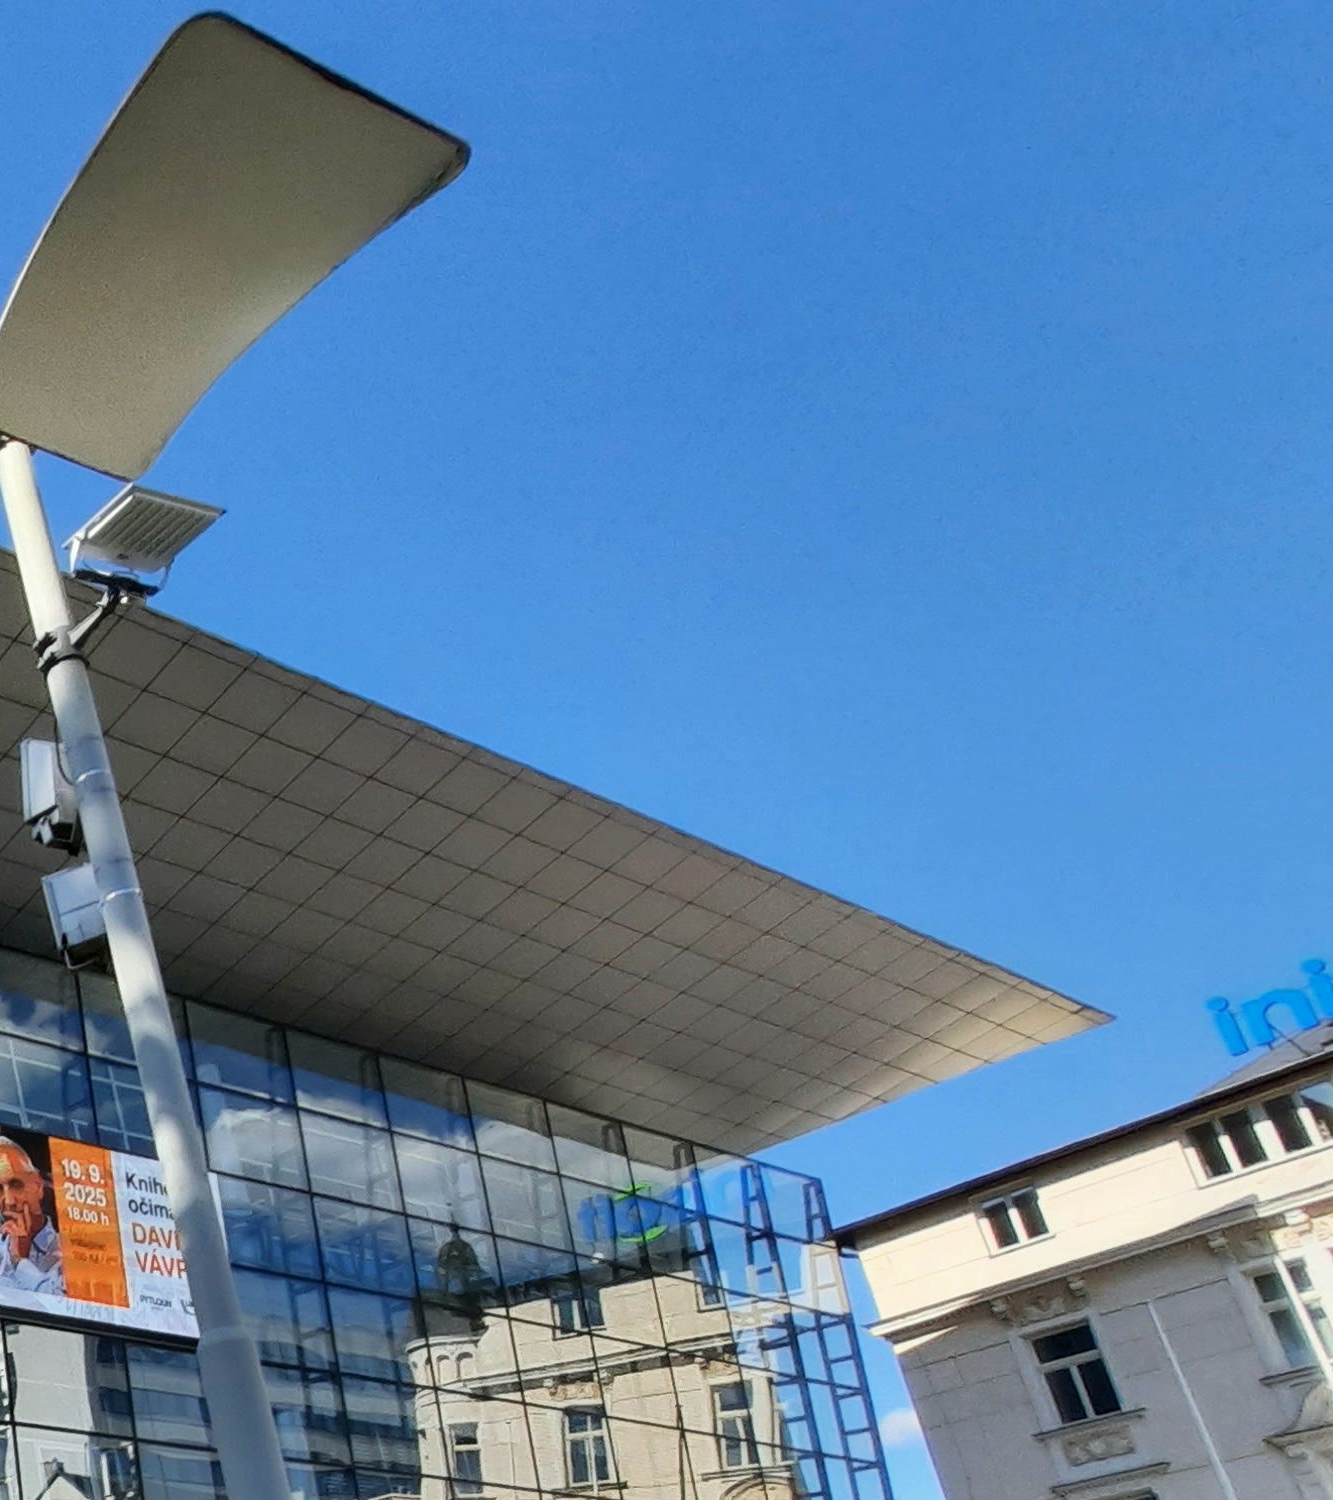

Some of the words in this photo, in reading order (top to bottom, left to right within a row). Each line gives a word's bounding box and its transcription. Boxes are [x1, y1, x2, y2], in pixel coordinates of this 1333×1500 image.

[61, 1158, 86, 1179] 19.
[89, 1164, 106, 1184] 9.
[63, 1182, 107, 1208] 2025
[67, 1206, 99, 1224] 18.00
[100, 1213, 110, 1226] h
